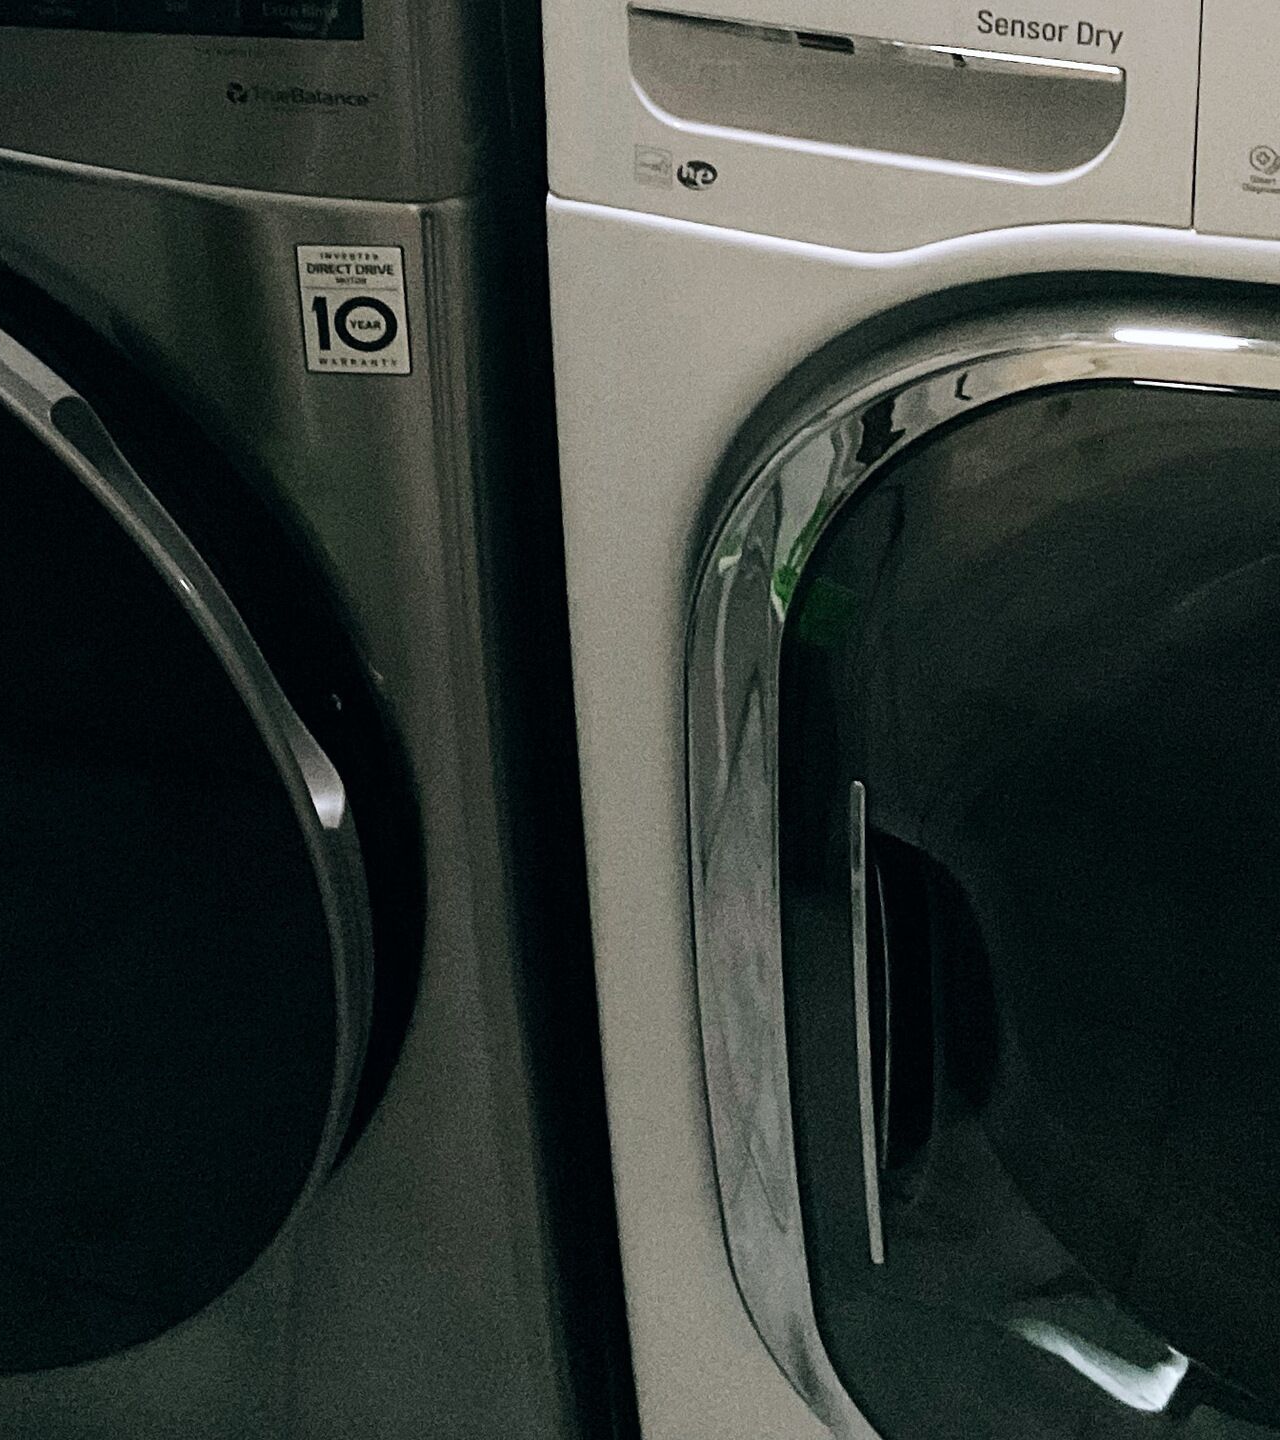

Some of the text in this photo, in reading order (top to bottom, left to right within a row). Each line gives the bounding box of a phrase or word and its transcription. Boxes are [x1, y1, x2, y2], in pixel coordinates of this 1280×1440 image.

[976, 9, 1125, 55] Sensor Dry
[306, 262, 395, 276] DIRECT DRIVE
[311, 295, 398, 353] 10
[350, 319, 382, 330] YEAR
[319, 357, 398, 367] WARRANTY
